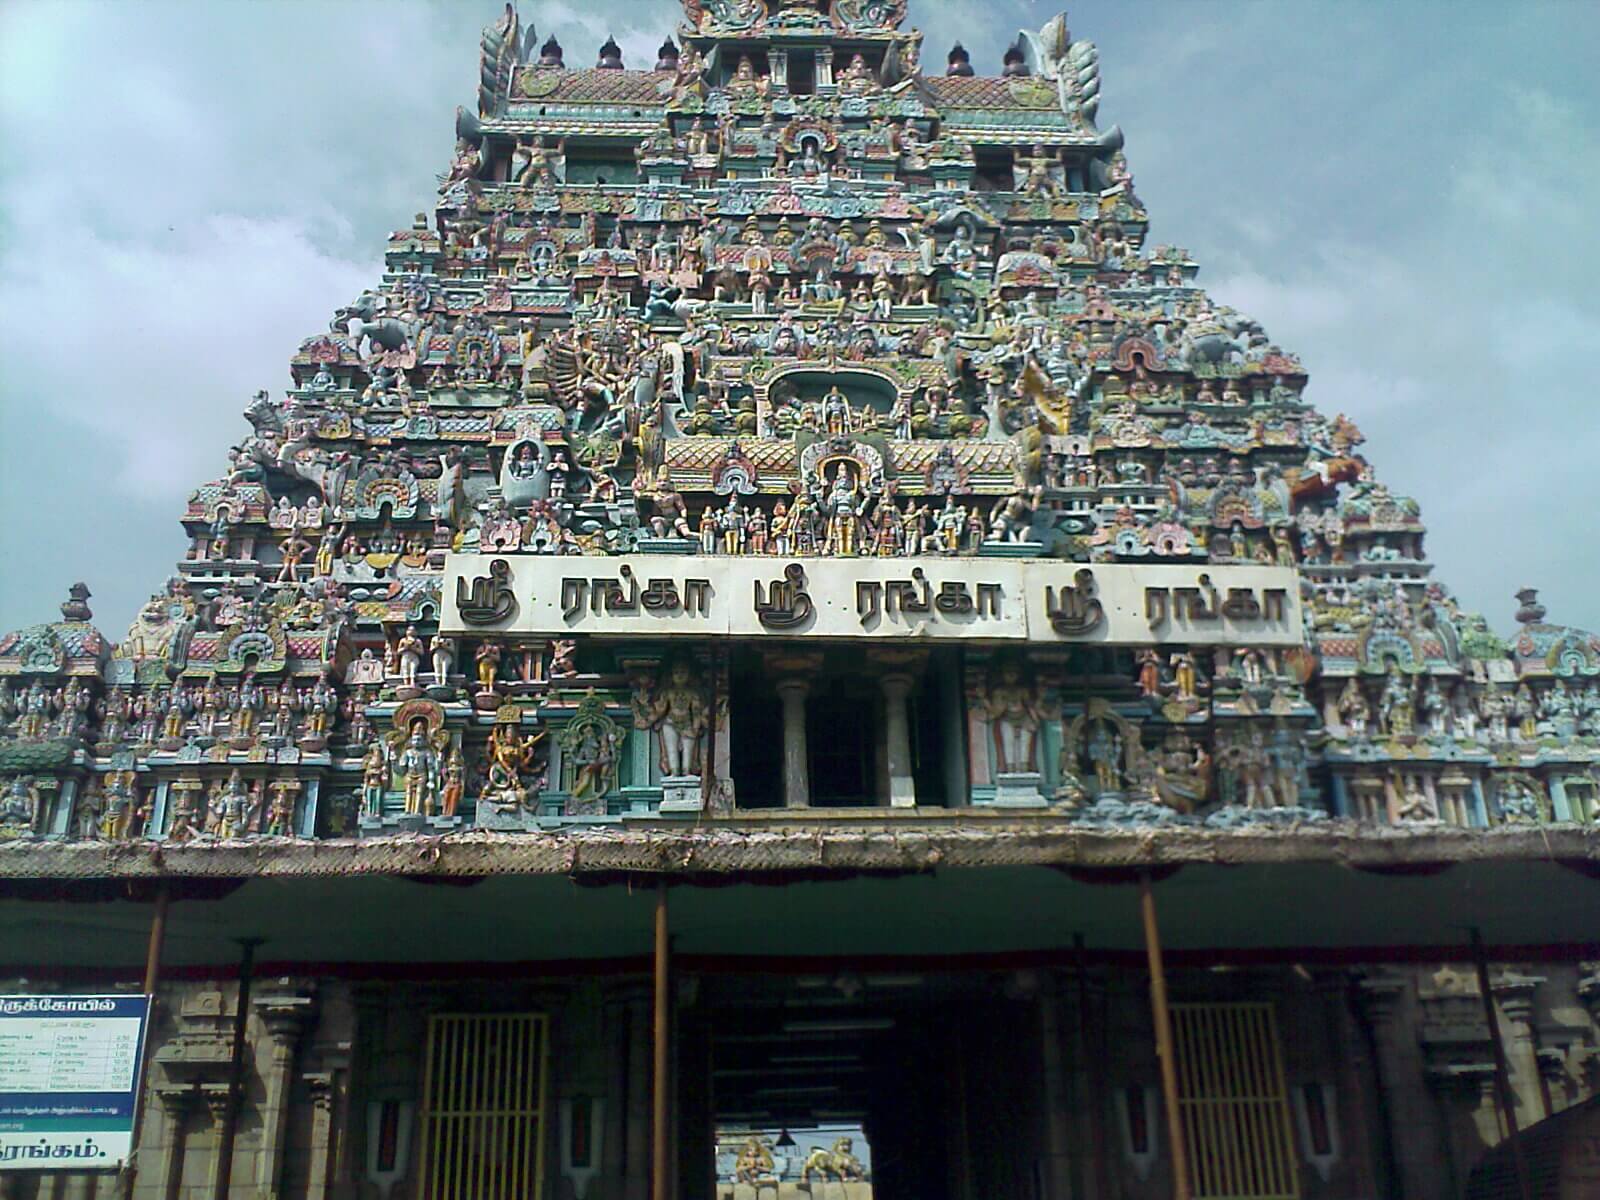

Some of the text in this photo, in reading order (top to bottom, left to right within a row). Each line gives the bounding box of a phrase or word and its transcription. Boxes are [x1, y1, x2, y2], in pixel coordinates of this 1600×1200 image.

[560, 564, 711, 623] ரங்கா
[856, 567, 1002, 627] ரங்கா
[1144, 573, 1287, 631] ரங்கா
[0, 1137, 106, 1160] ரங்கம்.
